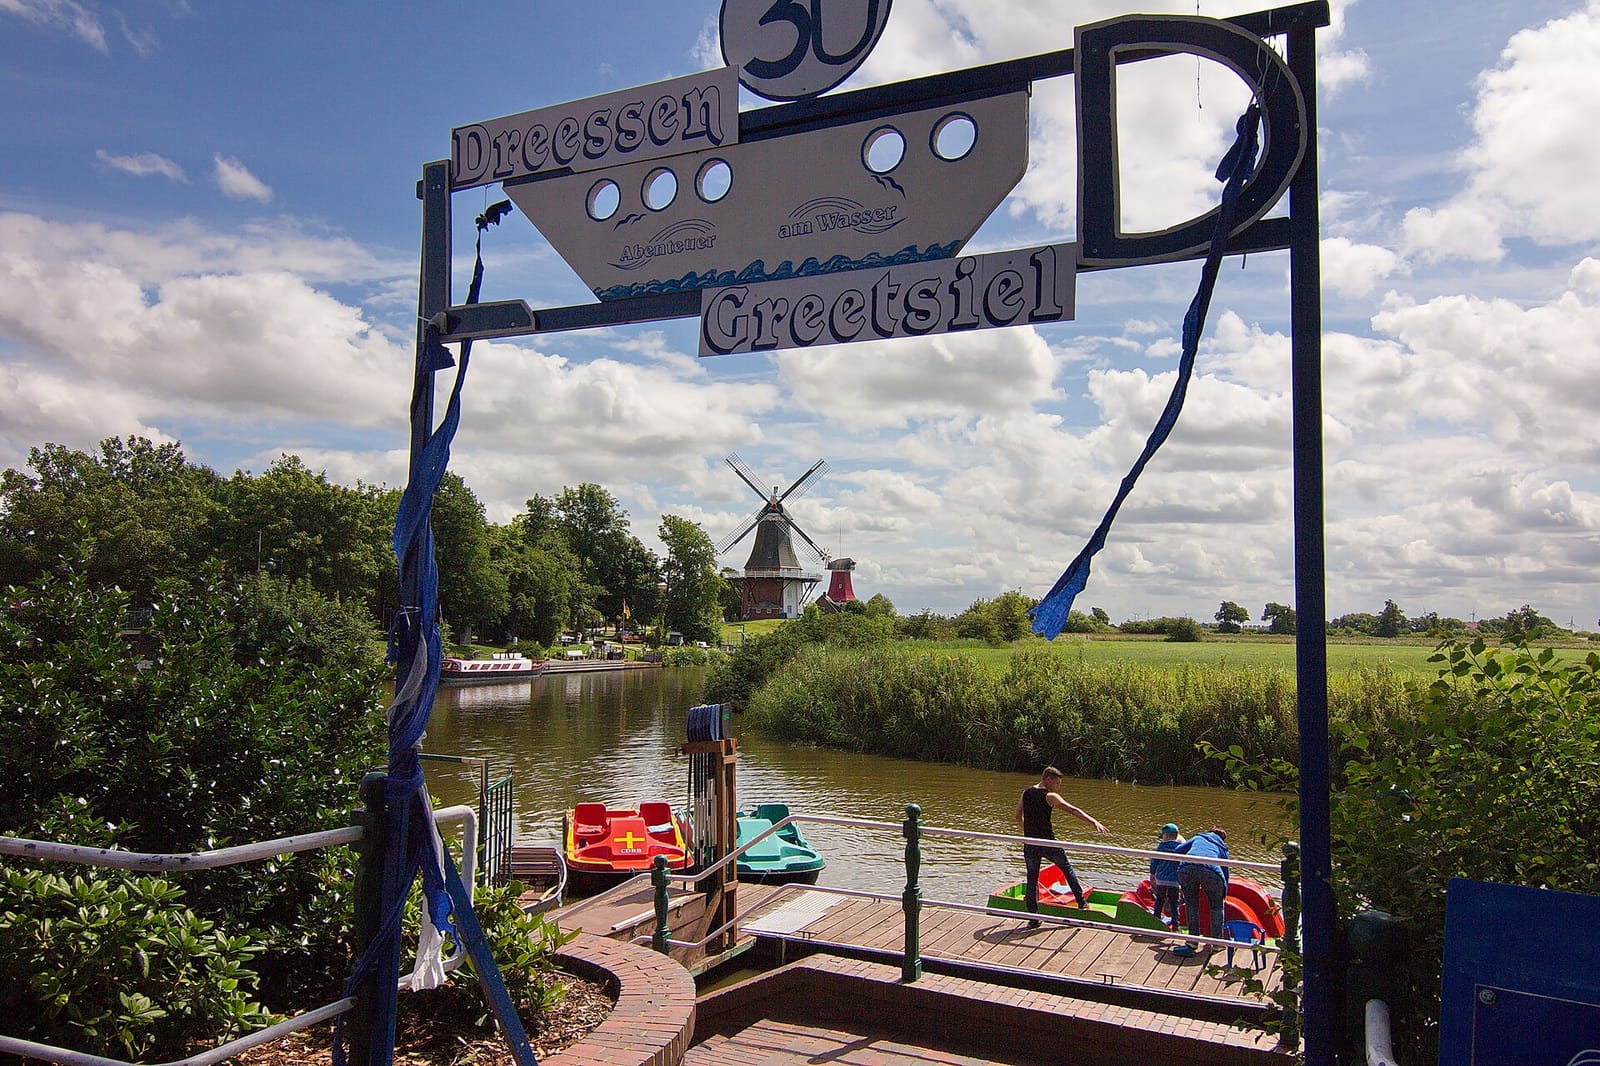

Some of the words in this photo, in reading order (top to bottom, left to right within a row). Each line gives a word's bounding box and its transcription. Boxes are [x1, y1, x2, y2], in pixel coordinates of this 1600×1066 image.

[453, 86, 724, 184] Dreessen
[620, 233, 717, 262] Abenteuer
[778, 220, 813, 239] am
[816, 205, 897, 231] Wasser
[703, 246, 1063, 355] Greetsiel
